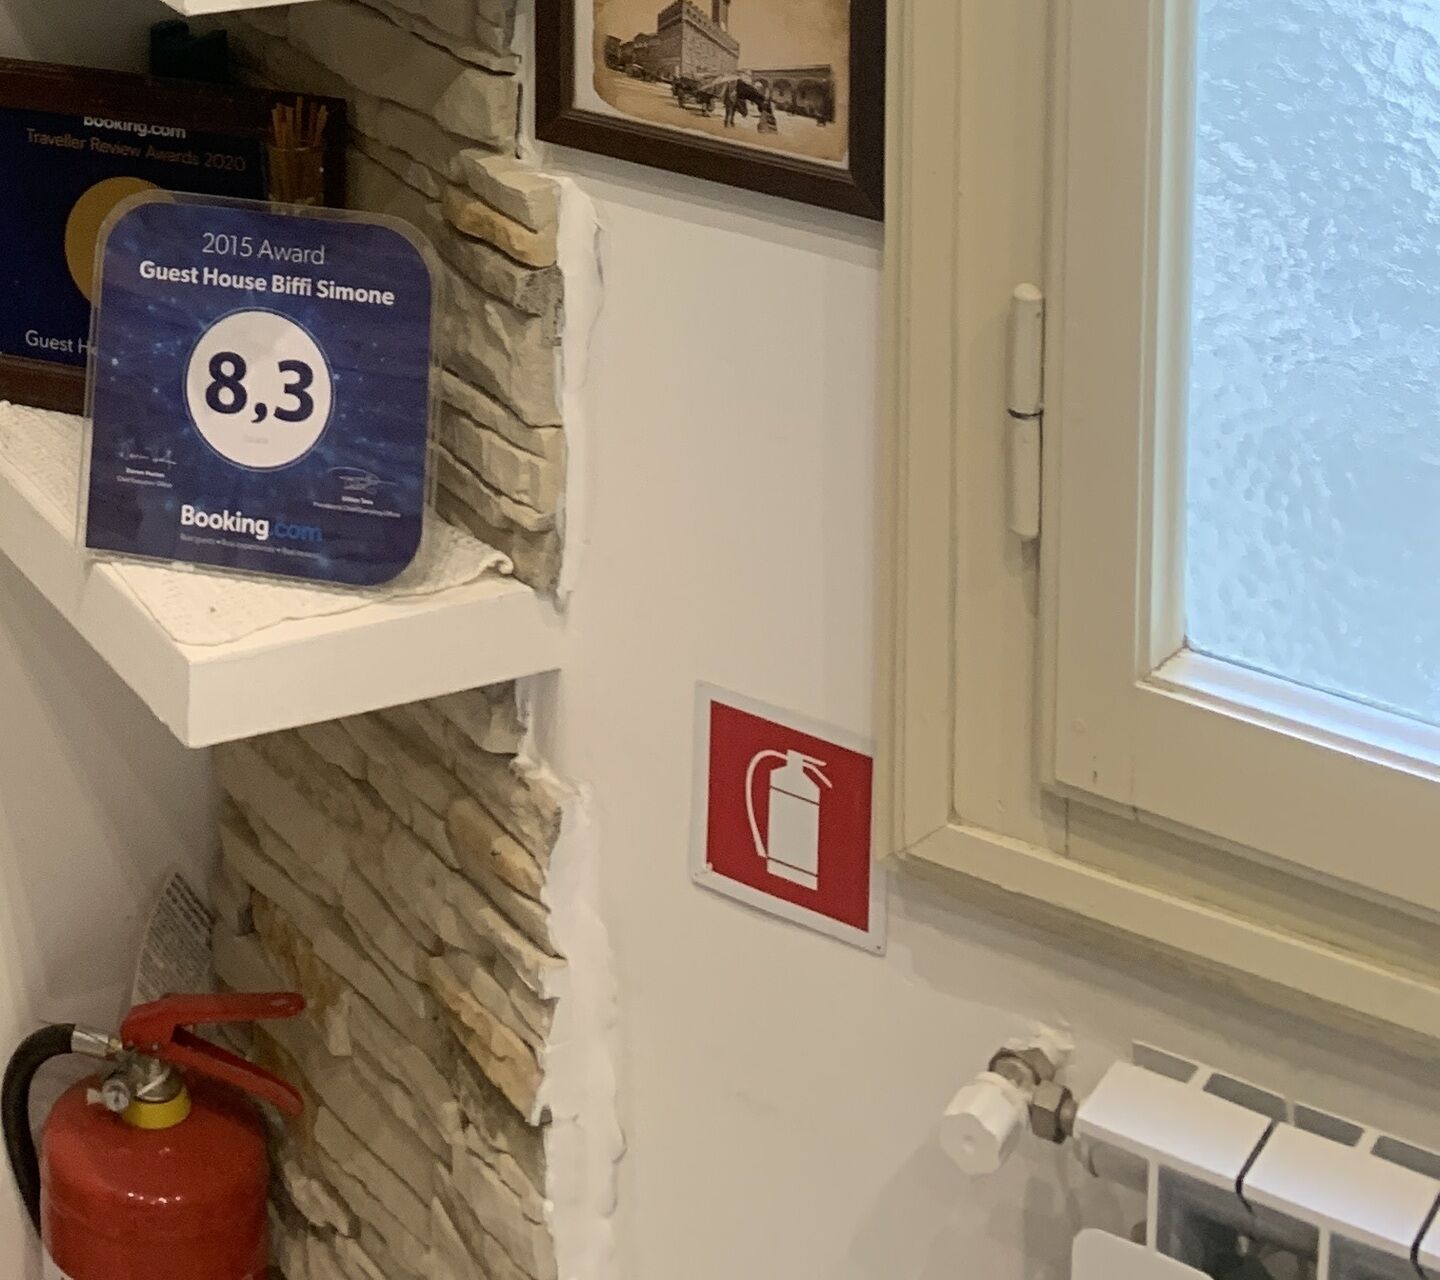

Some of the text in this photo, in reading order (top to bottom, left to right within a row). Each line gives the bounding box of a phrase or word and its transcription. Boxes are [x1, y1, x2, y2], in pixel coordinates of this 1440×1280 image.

[27, 127, 87, 150] Traveller
[90, 137, 141, 158] Review
[145, 144, 200, 166] Awards
[202, 232, 325, 265] 2015 Award
[139, 260, 395, 306] Guest House Biffi Simone
[25, 329, 73, 353] Guest
[204, 350, 315, 425] 8,3
[180, 504, 323, 541] Booking.com
